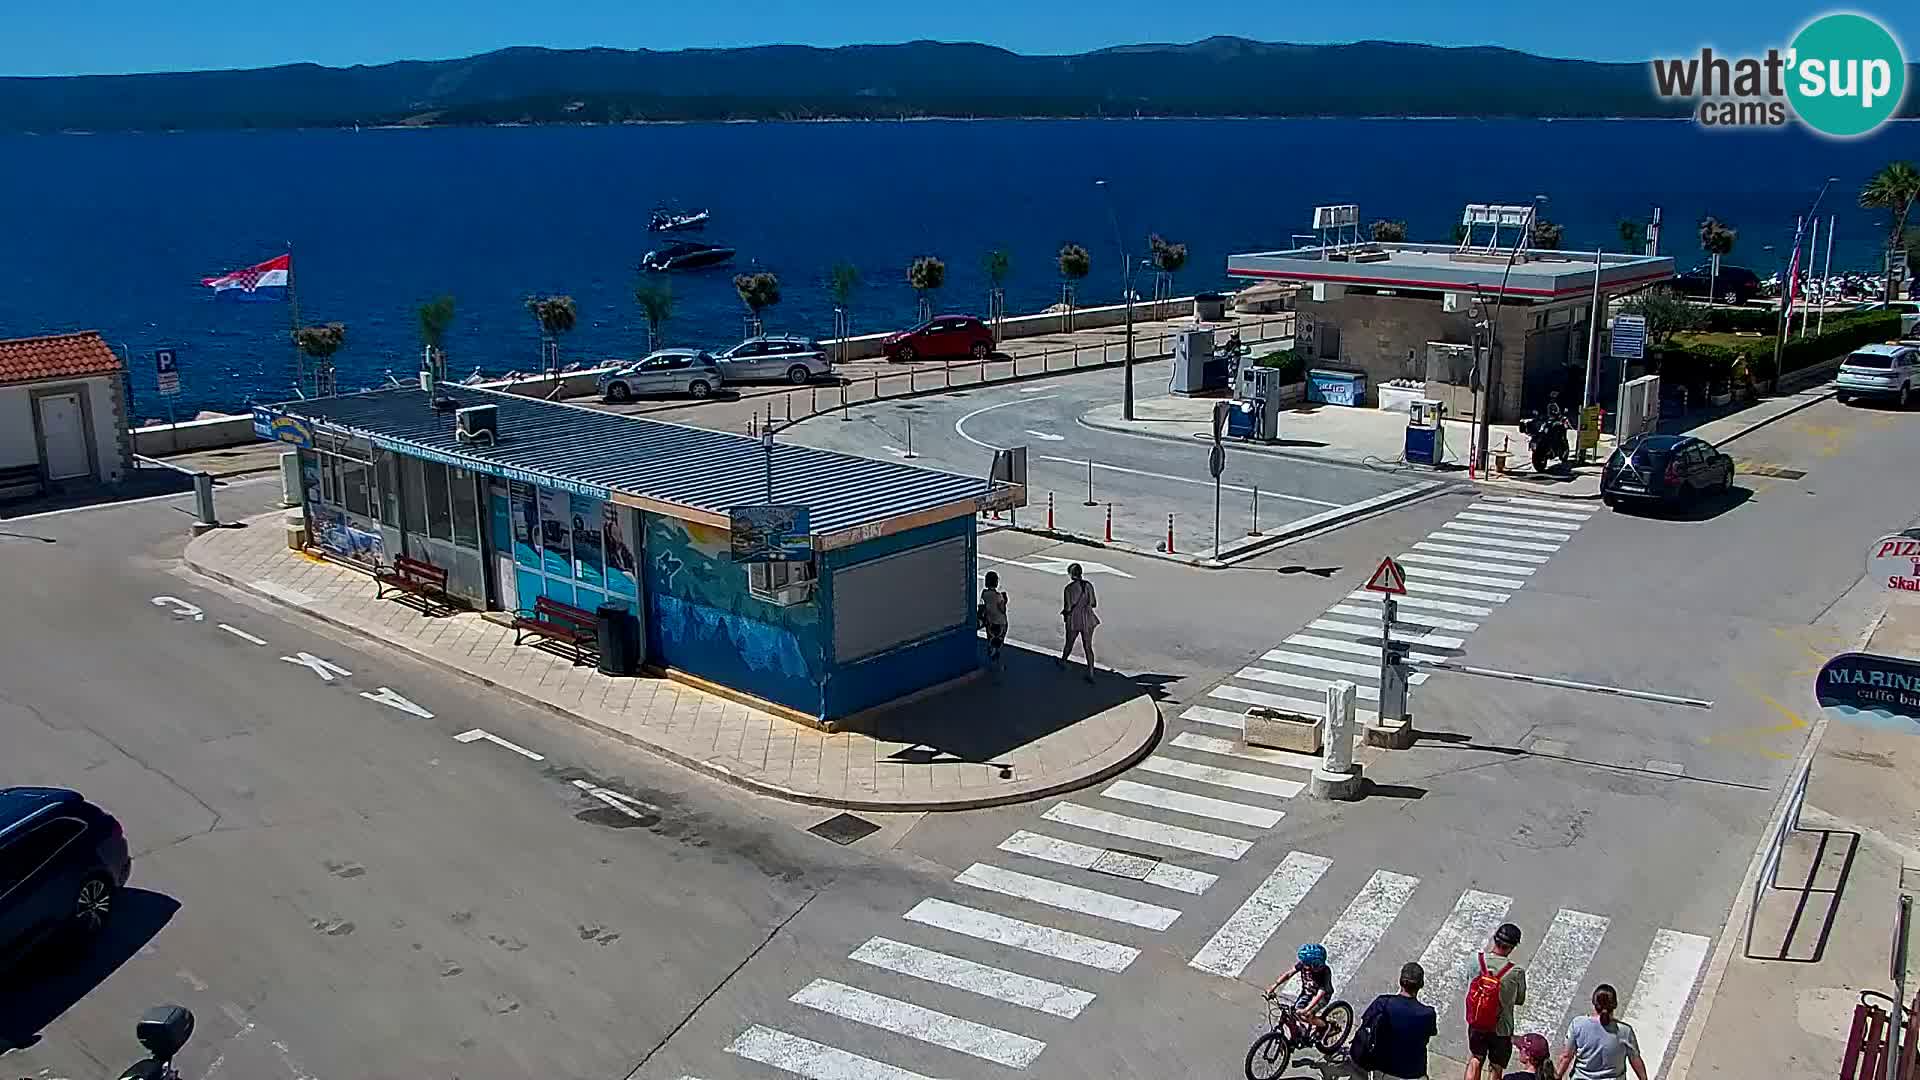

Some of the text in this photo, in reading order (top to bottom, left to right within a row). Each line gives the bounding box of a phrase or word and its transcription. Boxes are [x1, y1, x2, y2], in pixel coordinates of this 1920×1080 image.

[160, 352, 172, 370] P
[504, 468, 517, 480] BUS
[519, 471, 551, 487] STATION
[554, 479, 578, 492] TICKET
[580, 484, 607, 499] OFFICE
[1876, 541, 1920, 558] PIZ
